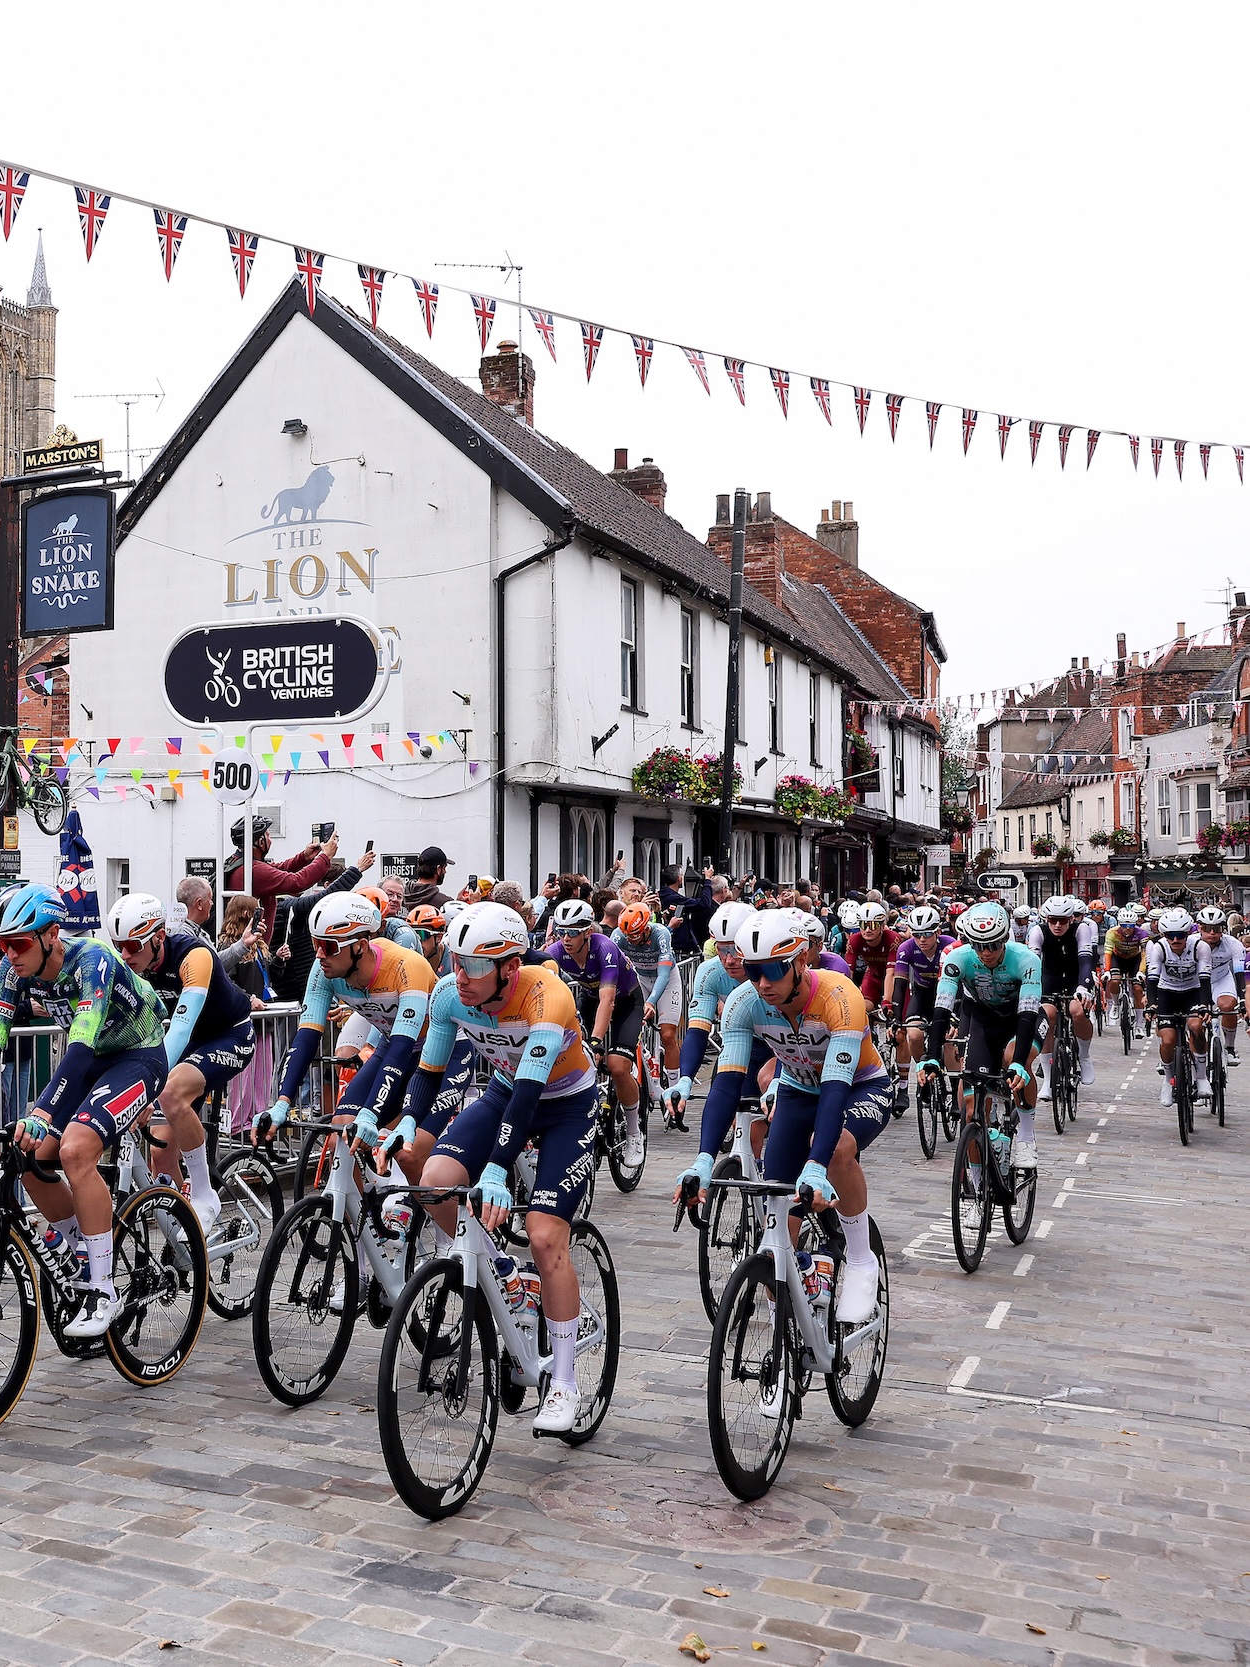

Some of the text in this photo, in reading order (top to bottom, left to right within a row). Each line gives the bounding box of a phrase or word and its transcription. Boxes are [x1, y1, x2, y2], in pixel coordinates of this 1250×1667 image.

[25, 445, 98, 467] MARSTON'S
[56, 536, 75, 545] THE
[272, 528, 323, 550] THE
[39, 543, 93, 567] LION
[55, 564, 75, 573] AND
[223, 548, 380, 608] LION
[31, 570, 101, 595] SNAKE
[242, 643, 334, 670] BRITISH
[242, 665, 334, 690] CYCLING
[270, 686, 334, 701] VENTURES
[213, 761, 252, 791] 500
[0, 854, 21, 862] PRIVATE
[0, 862, 21, 871] PARKING
[392, 856, 406, 865] THE
[383, 865, 416, 876] BIGGEST
[670, 989, 680, 1013] INEOS
[207, 1053, 245, 1069] FANTINI
[373, 1074, 395, 1114] NSN
[116, 1095, 147, 1128] SOUDAL
[565, 1151, 591, 1175] CANTINA
[531, 1199, 558, 1208] CHANGE
[533, 1190, 558, 1199] RACING
[135, 1196, 178, 1221] roval
[7, 1243, 37, 1307] roval
[141, 1349, 182, 1376] roval
